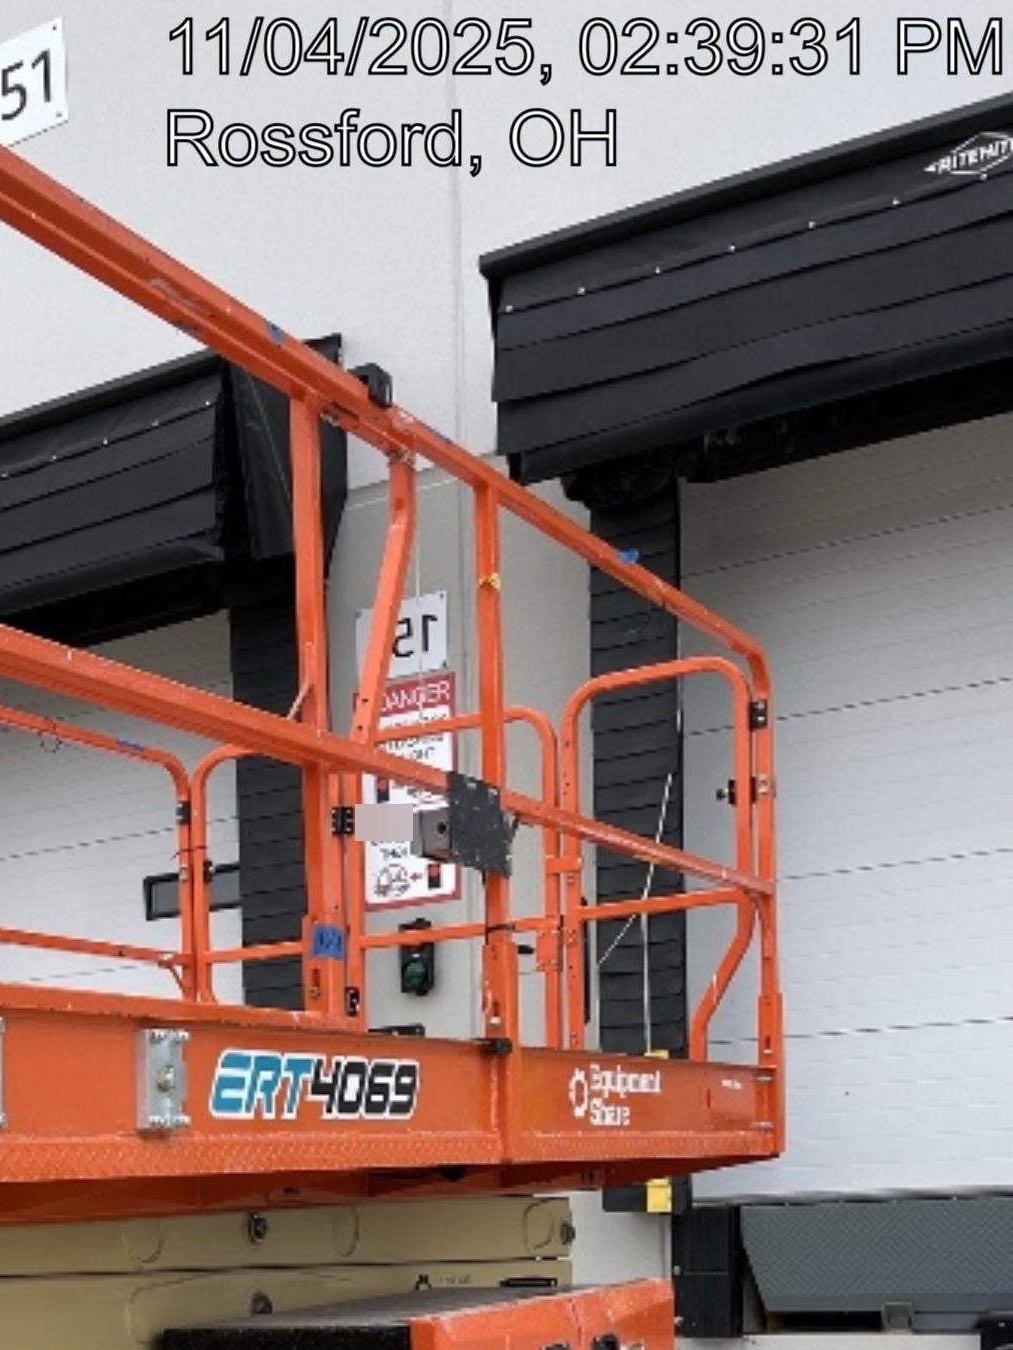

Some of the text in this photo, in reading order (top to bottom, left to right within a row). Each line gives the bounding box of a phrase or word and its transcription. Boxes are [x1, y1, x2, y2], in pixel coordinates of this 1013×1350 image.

[210, 1048, 421, 1120] ERT4069
[589, 1063, 662, 1099] Equipment
[589, 1097, 631, 1127] Share
